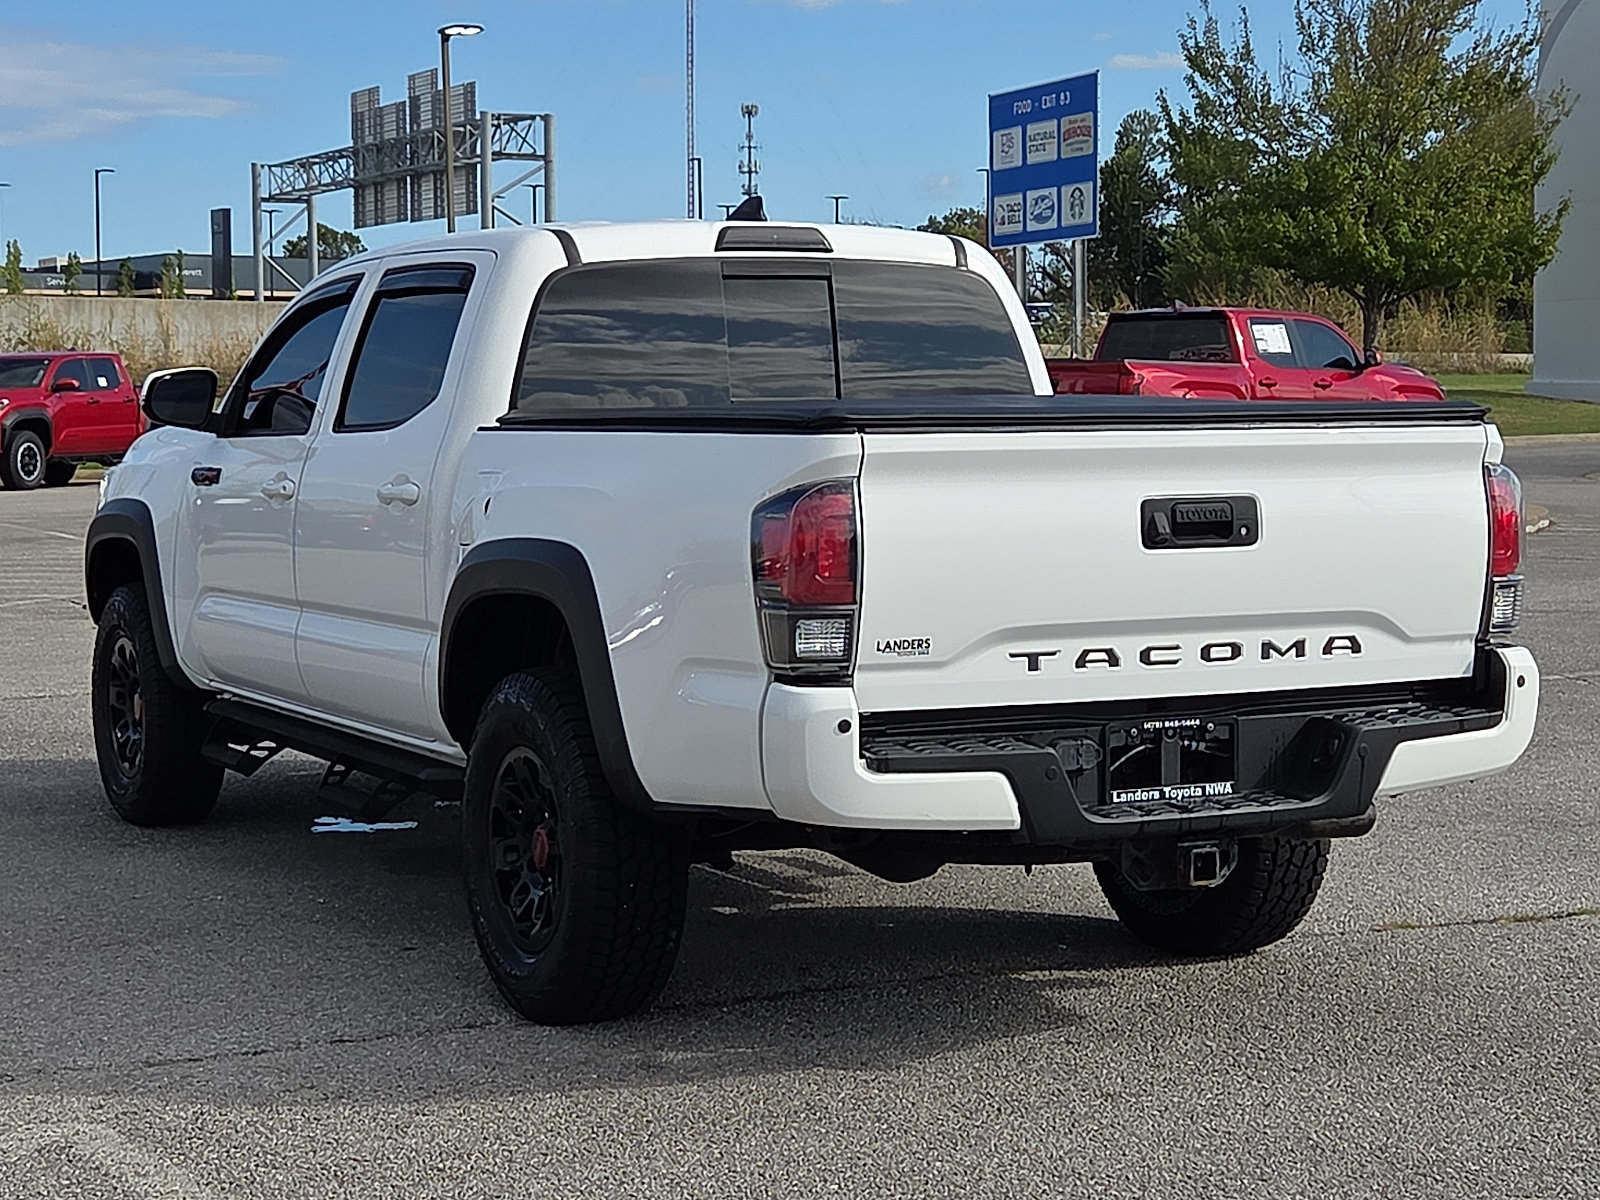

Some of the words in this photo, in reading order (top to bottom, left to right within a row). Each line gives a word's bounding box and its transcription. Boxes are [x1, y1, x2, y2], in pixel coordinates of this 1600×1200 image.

[1013, 99, 1032, 115] FOOD
[1041, 94, 1056, 109] EXIT
[1028, 129, 1056, 143] NATURAL
[1028, 142, 1047, 155] STATE
[1006, 202, 1021, 213] TACO
[1178, 507, 1229, 521] TOYOTA
[876, 638, 931, 653] LANDERS
[1008, 635, 1362, 672] TACOMA
[1112, 789, 1160, 803] Landers
[1163, 785, 1202, 800] Toyota
[1205, 783, 1233, 796] NWA
